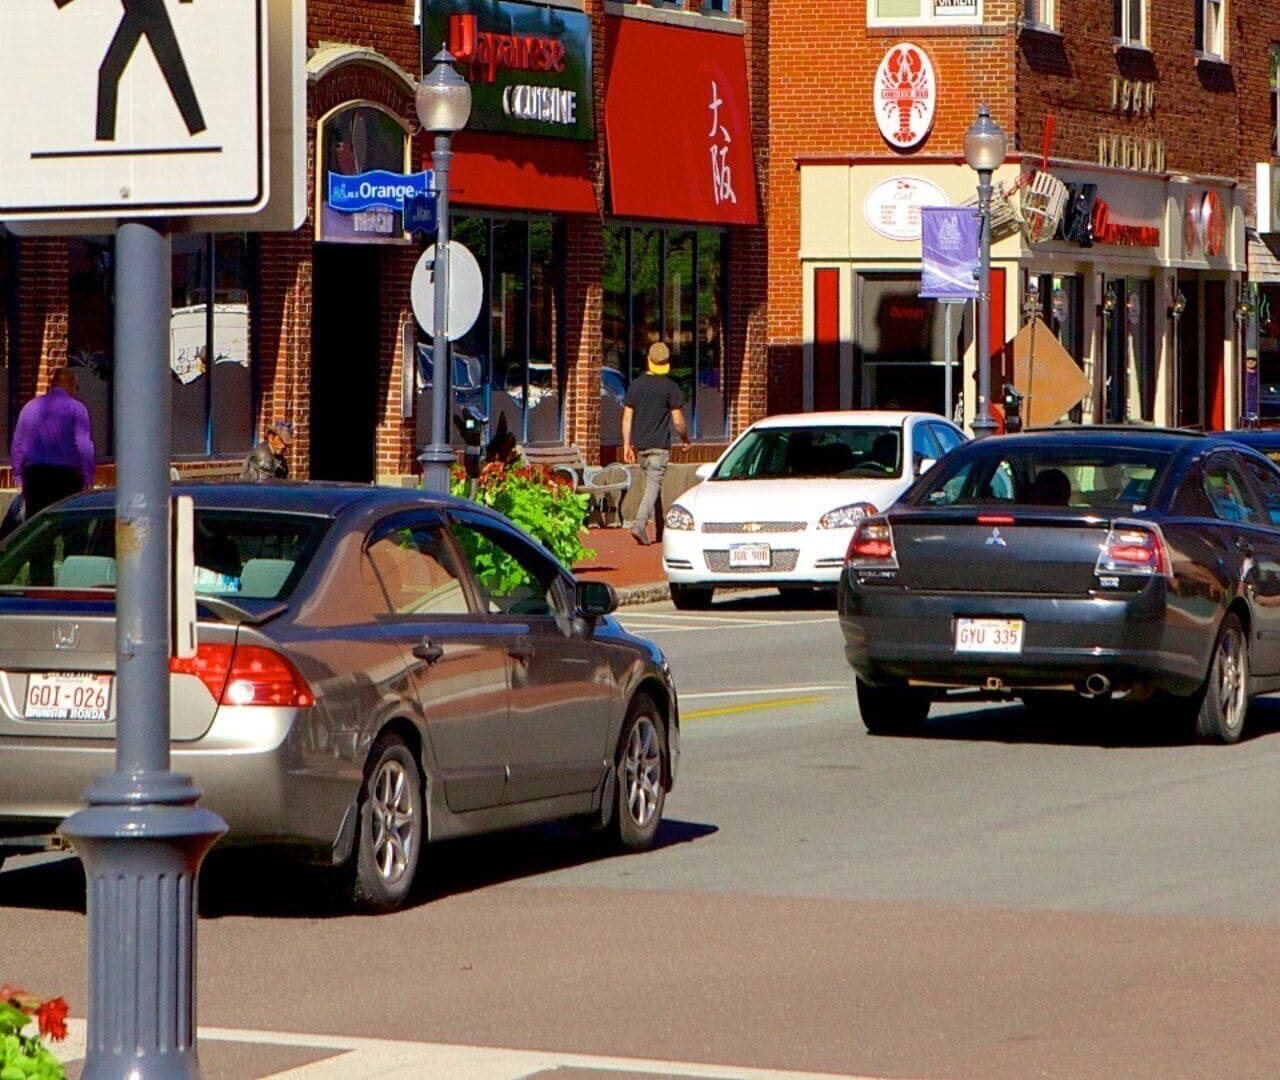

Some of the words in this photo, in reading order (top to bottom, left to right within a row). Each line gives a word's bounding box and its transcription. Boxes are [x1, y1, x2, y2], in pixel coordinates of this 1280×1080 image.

[449, 14, 565, 82] Japanese
[503, 85, 577, 124] CUISINE
[359, 182, 414, 202] Orange
[960, 628, 985, 643] GYU
[994, 628, 1018, 644] 335
[70, 709, 106, 720] HONDA
